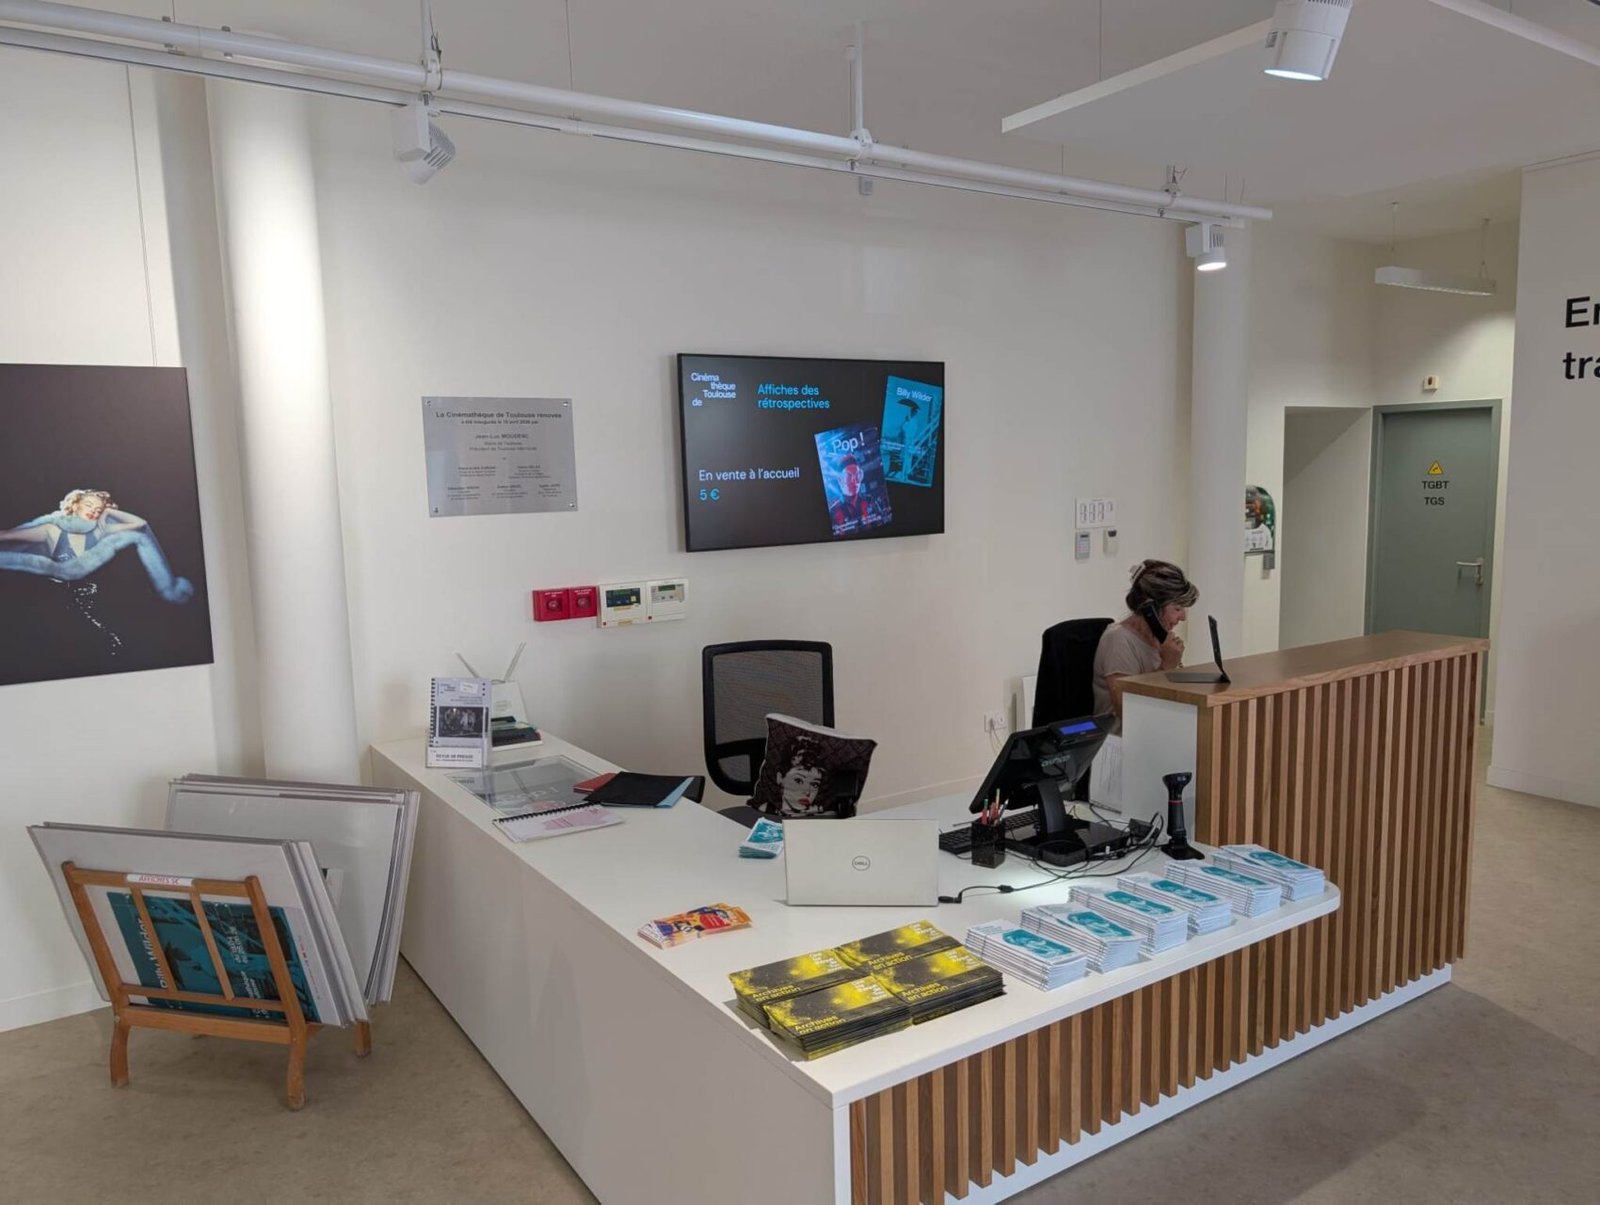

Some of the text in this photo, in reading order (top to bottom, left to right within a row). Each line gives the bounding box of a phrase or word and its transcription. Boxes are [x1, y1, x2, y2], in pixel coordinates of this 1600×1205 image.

[690, 372, 720, 382] Cinéma
[710, 382, 736, 392] thèque
[757, 384, 820, 396] Affiches des
[703, 389, 736, 398] Toulouse
[911, 390, 933, 402] Wilder
[691, 398, 703, 407] de
[757, 397, 831, 411] rétrospectives
[698, 467, 800, 481] En vente à l'accueil
[1421, 480, 1450, 490] TGBT
[699, 488, 720, 501] 5 €
[1424, 496, 1445, 506] TGS
[752, 984, 795, 999] Archives
[902, 982, 941, 997] Archives
[920, 986, 949, 998] action
[795, 1015, 838, 1031] Archives
